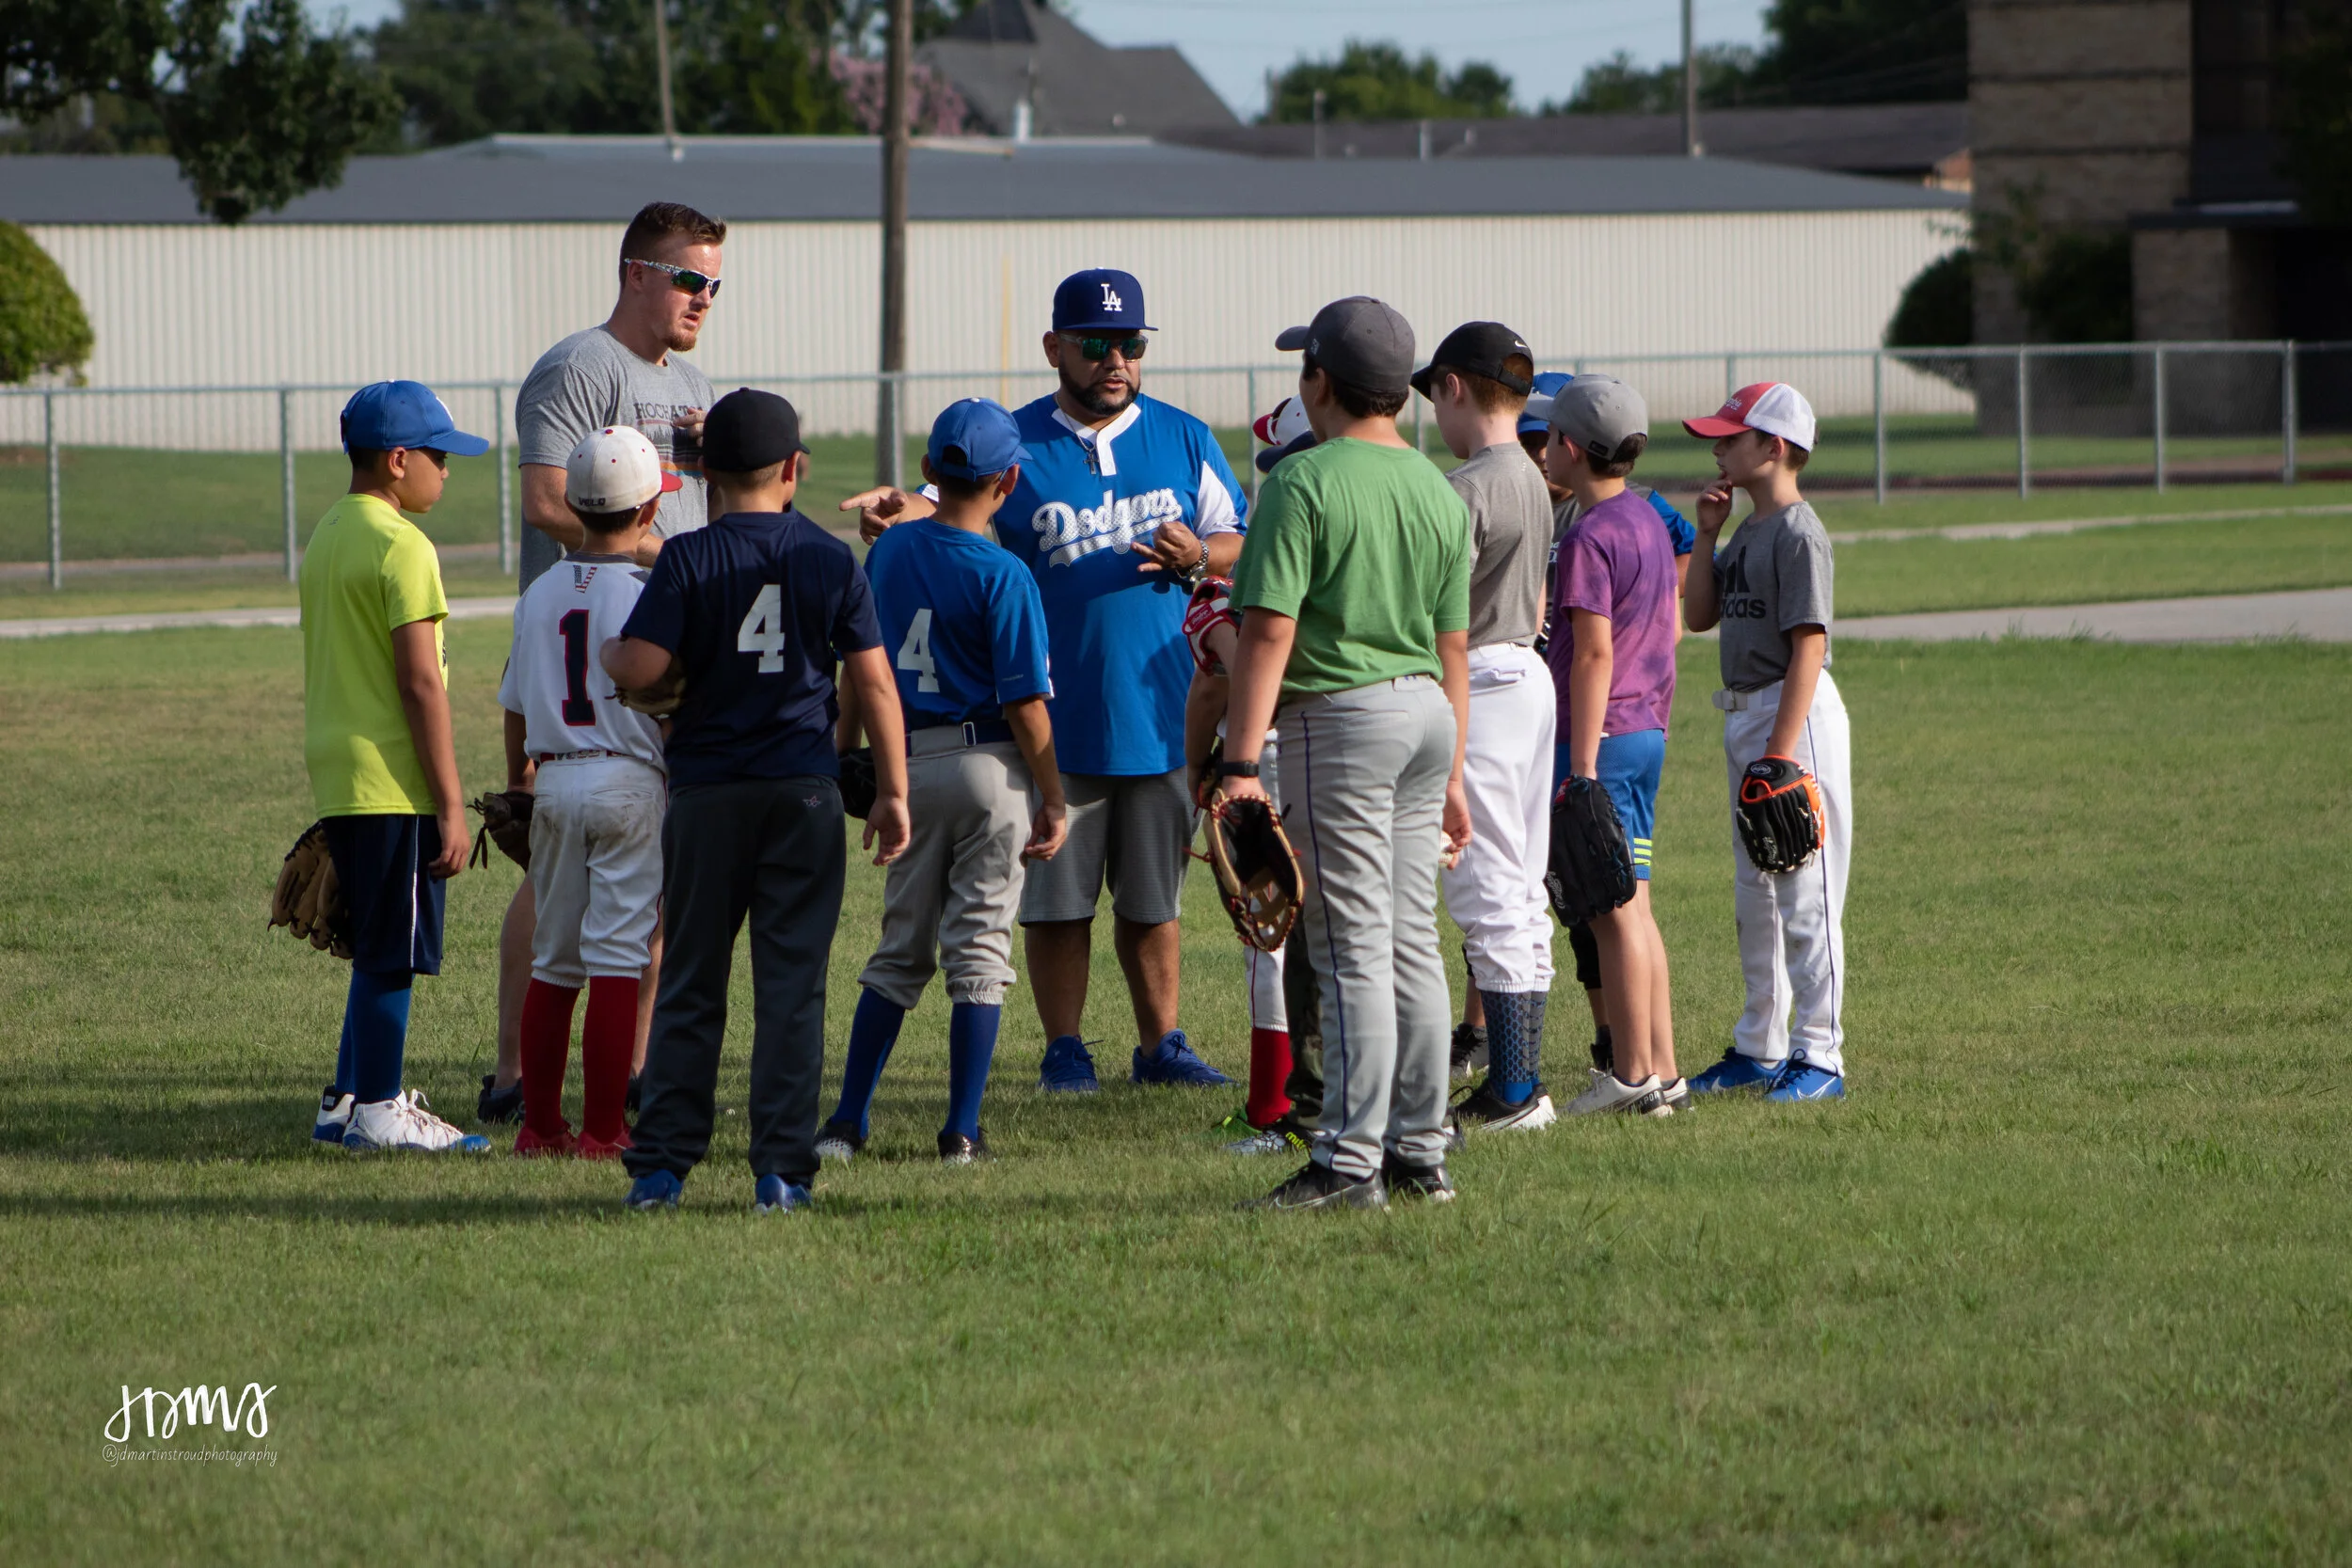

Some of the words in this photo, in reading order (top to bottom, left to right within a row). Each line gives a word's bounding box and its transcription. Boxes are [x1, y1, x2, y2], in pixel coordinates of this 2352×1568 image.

[1101, 283, 1122, 311] LA
[1032, 487, 1183, 555] Dodgers
[559, 609, 596, 727] 1
[738, 583, 785, 673] 4
[897, 608, 940, 693] 4
